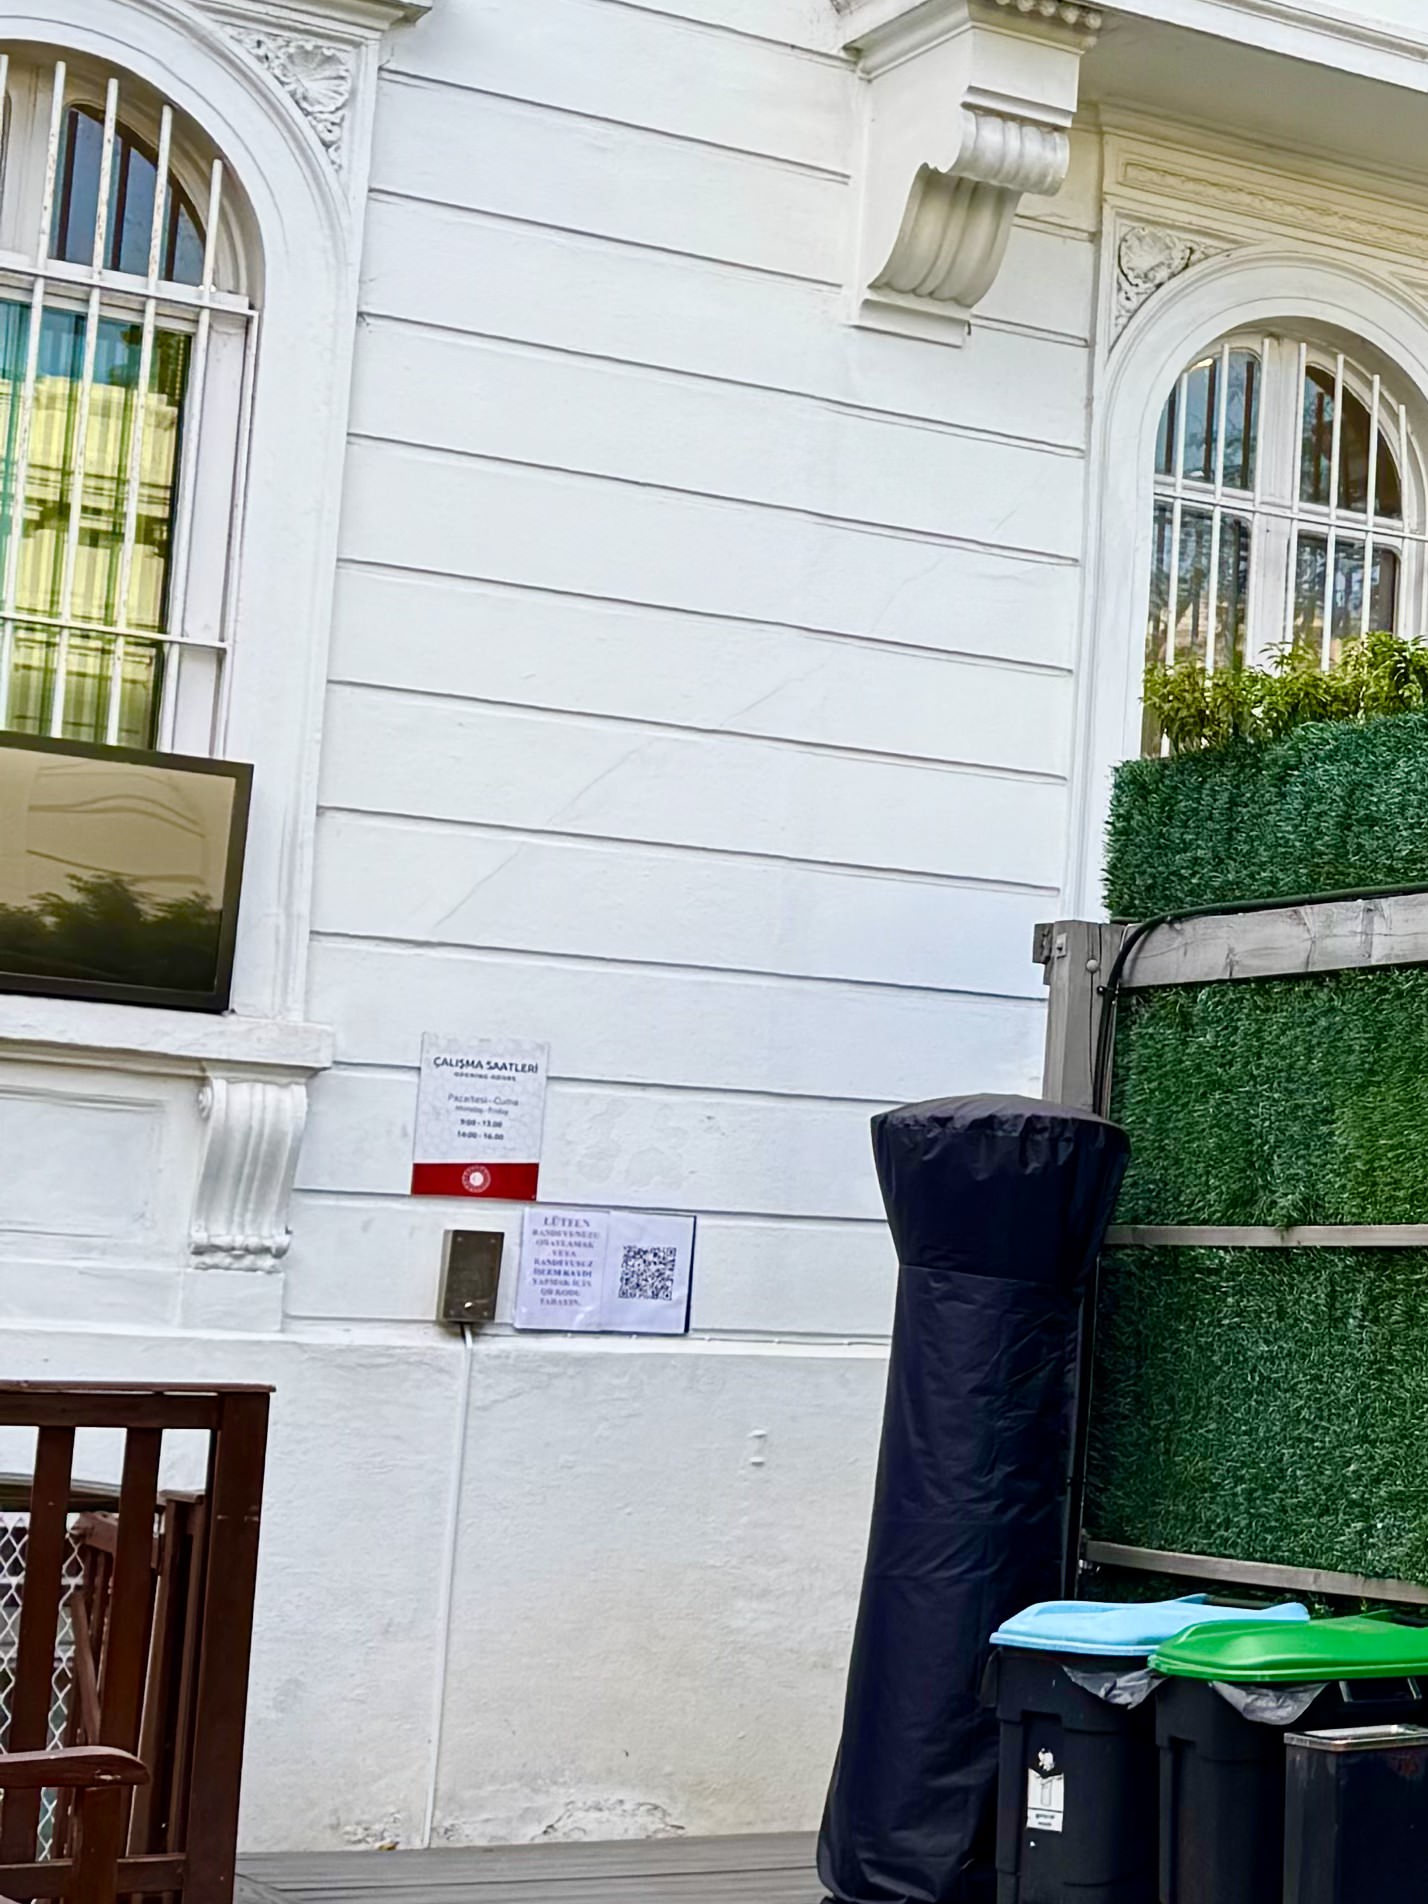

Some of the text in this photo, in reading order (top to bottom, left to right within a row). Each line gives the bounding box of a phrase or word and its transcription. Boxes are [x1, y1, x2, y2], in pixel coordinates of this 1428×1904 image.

[433, 1056, 539, 1074] ÇALIŞMA SAATLERİ
[544, 1215, 591, 1227] LÜTFEN
[552, 1249, 577, 1257] VEYA
